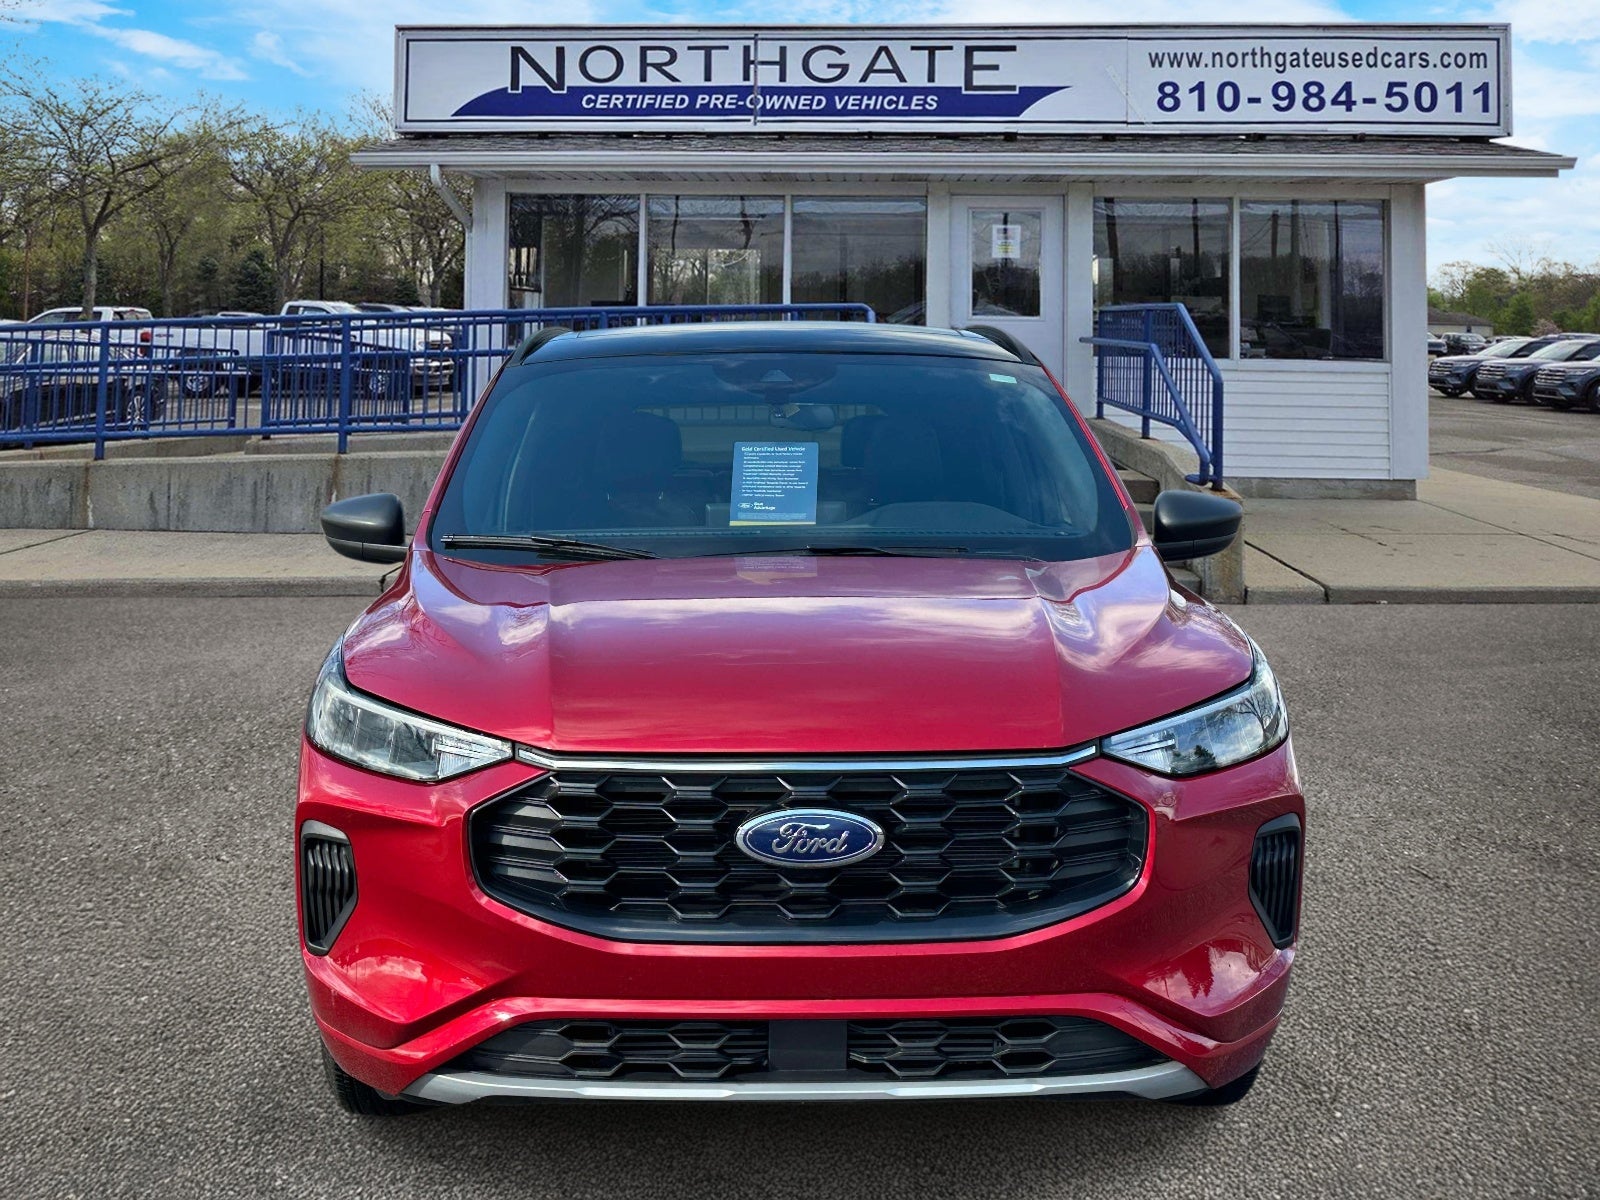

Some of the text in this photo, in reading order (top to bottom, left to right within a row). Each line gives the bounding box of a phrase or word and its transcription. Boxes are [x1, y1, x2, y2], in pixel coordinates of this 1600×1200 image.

[508, 44, 1018, 93] NORTHGATE
[1148, 45, 1489, 73] www.northgateusedcars.com
[581, 93, 939, 111] CERTIFIED PRE-OWNED VEHICLES
[1156, 79, 1491, 114] 810-984-5011
[771, 822, 850, 854] Ford
